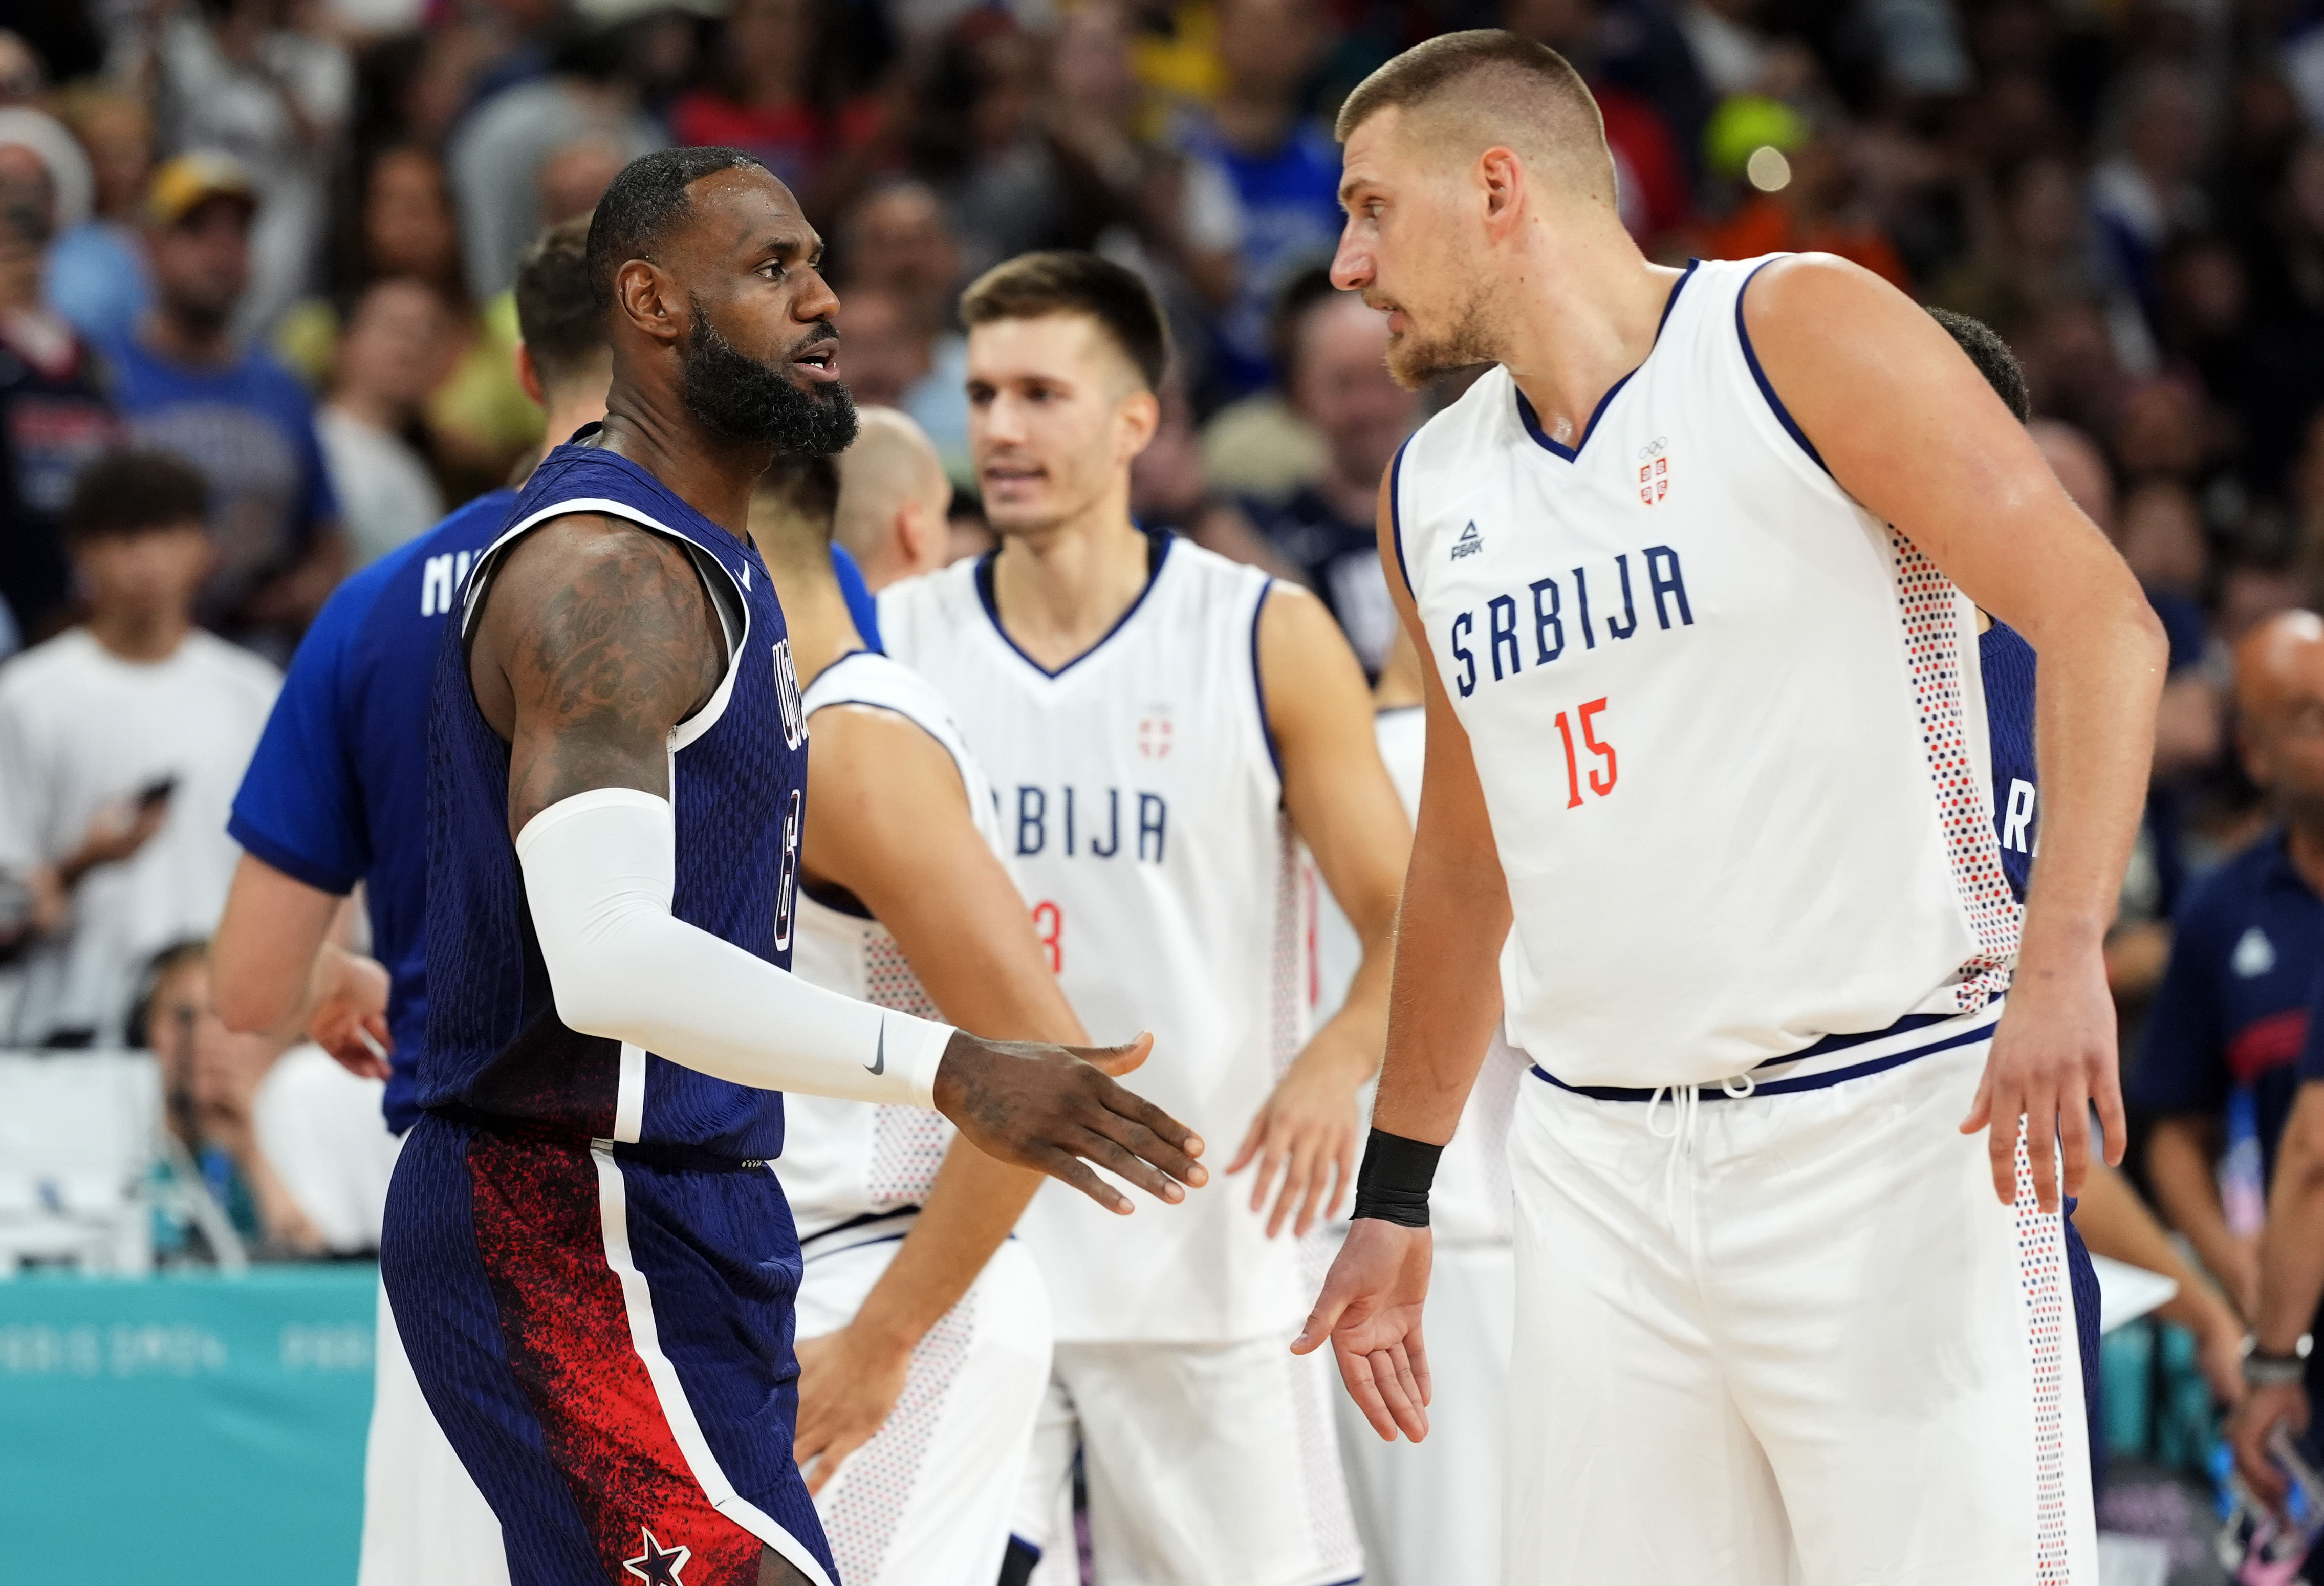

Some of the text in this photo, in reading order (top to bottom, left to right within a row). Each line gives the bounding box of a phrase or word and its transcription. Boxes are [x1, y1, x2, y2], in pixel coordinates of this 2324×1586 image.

[1450, 537, 1485, 561] PEAK
[1452, 545, 1694, 698] SRBIJA
[1554, 697, 1617, 809] 15
[991, 785, 1165, 863] BIJA
